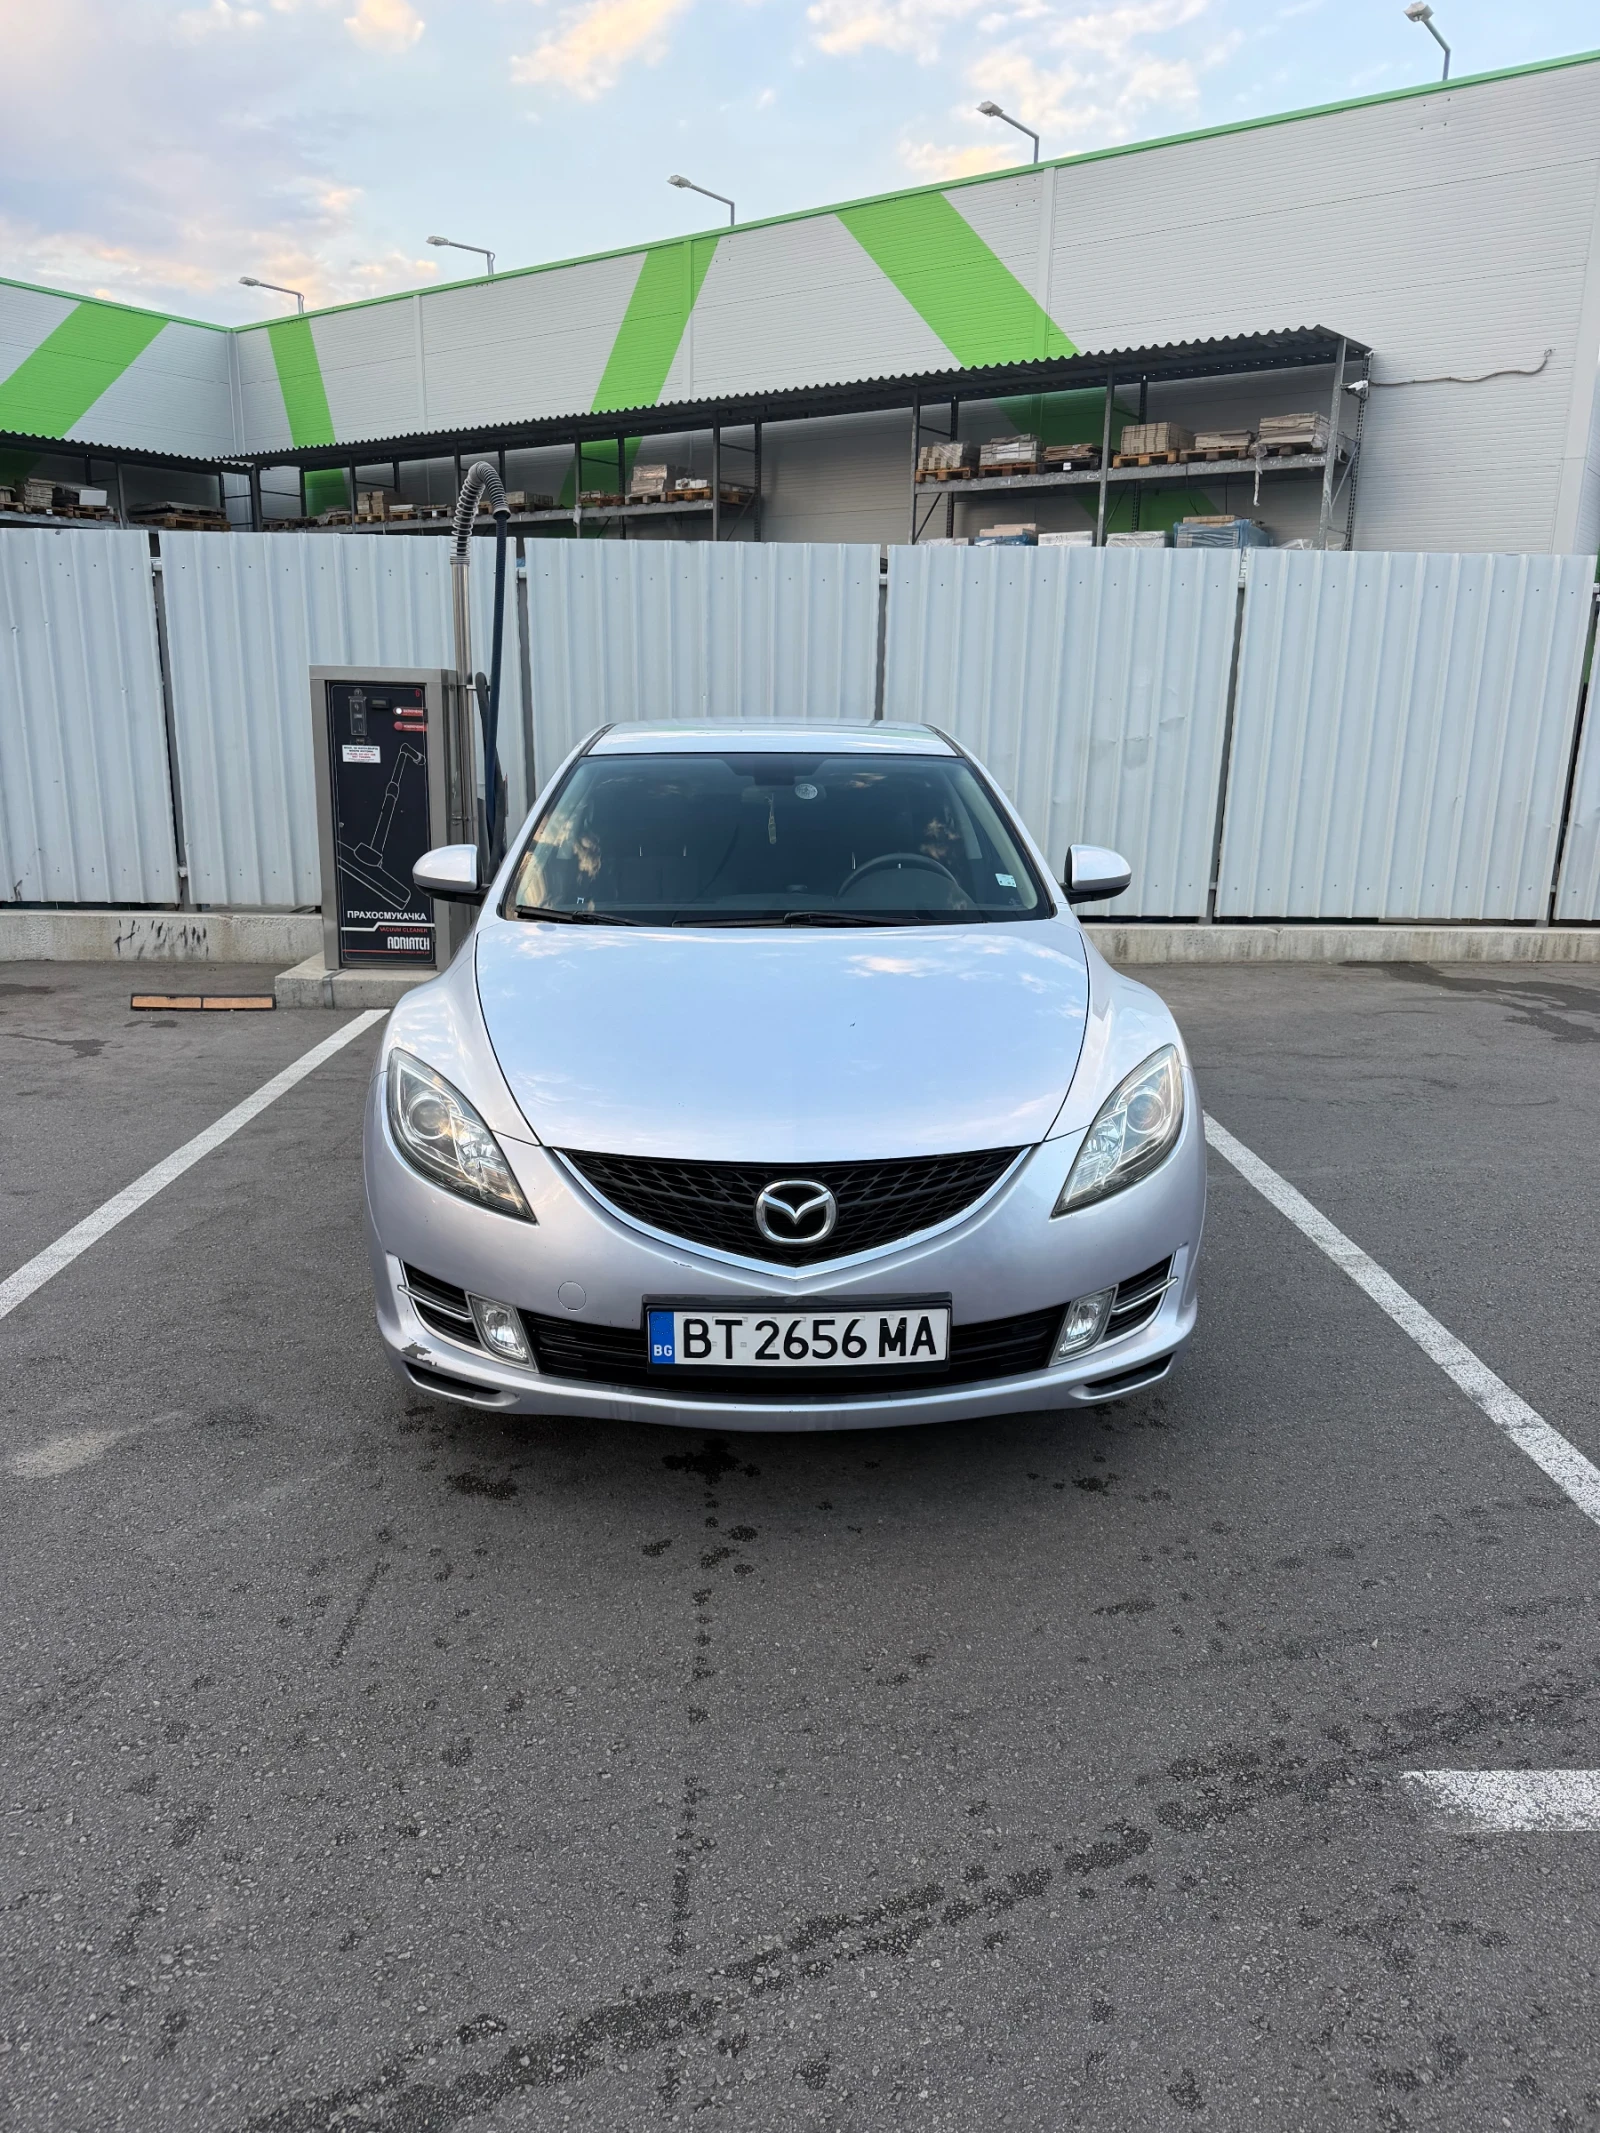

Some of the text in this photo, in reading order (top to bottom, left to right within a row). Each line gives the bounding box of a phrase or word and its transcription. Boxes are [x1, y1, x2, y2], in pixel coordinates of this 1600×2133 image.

[347, 910, 427, 920] ПРАХОСМУКАЧКА
[683, 1316, 937, 1360] BT 2656 MA
[653, 1343, 673, 1358] BG
